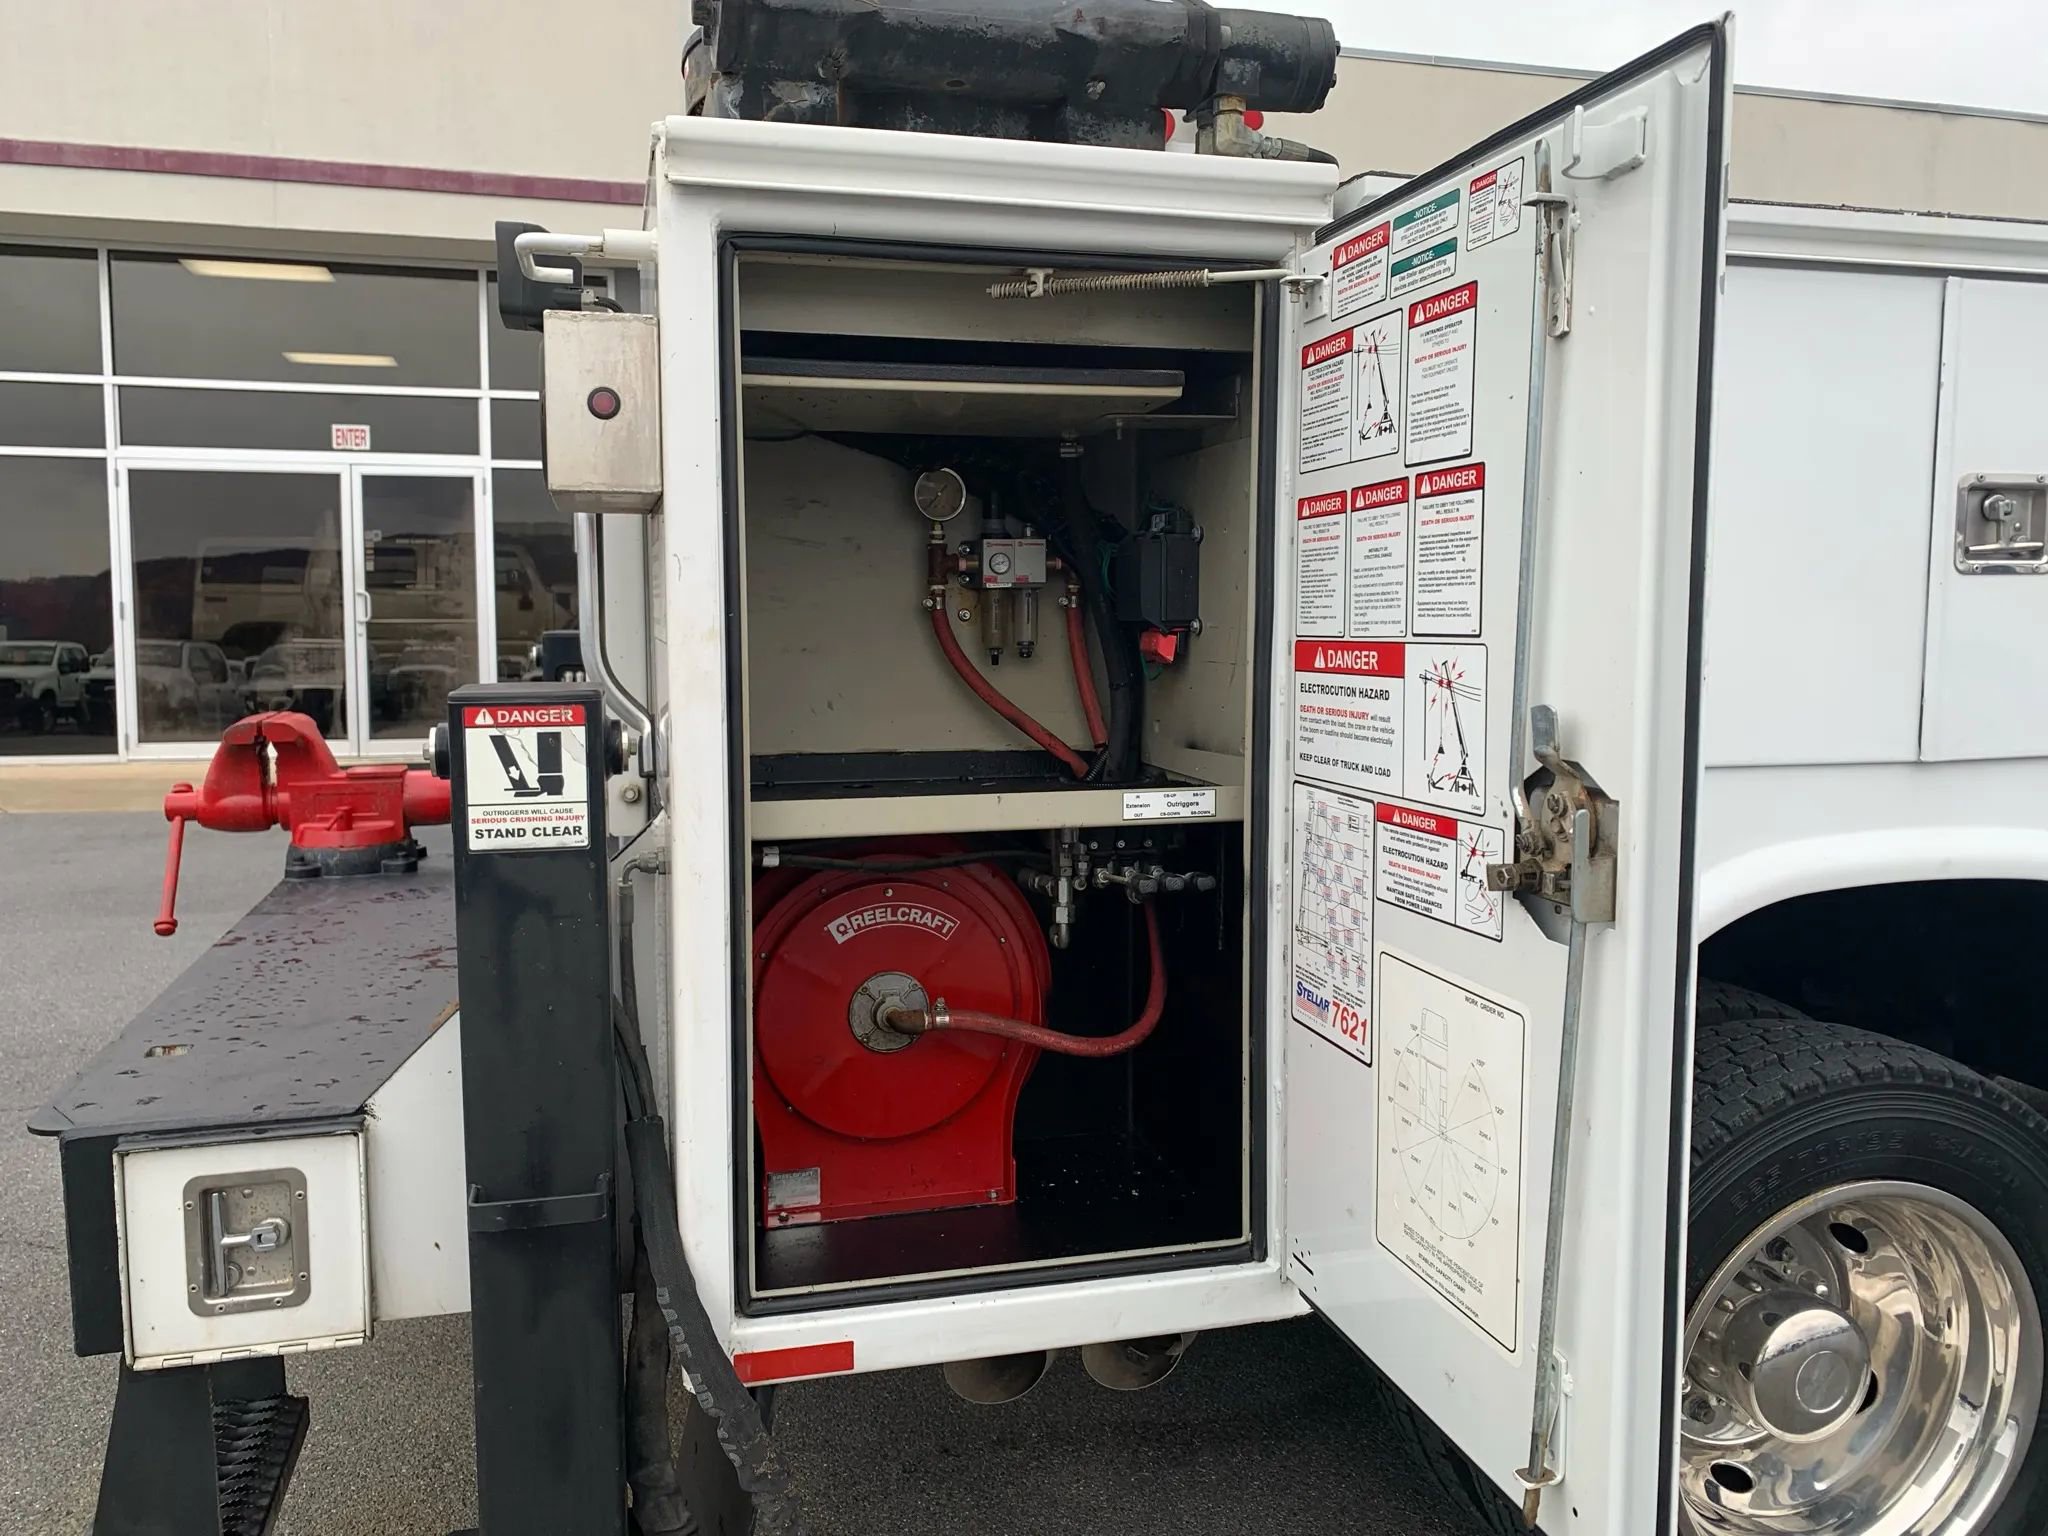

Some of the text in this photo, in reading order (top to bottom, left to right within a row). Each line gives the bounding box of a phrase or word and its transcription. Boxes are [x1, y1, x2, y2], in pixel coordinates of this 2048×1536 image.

[1477, 174, 1496, 187] DANGER
[1348, 230, 1384, 259] DANGER
[1426, 290, 1469, 318] DANGER
[1316, 337, 1346, 360] DANGER
[1415, 355, 1427, 364] DEATH
[1434, 348, 1451, 357] SERIOUS
[1452, 344, 1467, 352] INJURY
[336, 429, 367, 447] ENTER
[1433, 470, 1476, 490] DANGER
[1366, 486, 1402, 504] DANGER
[1311, 497, 1341, 514] DANGER
[1328, 650, 1378, 670] DANGER
[1300, 683, 1390, 700] ELECTROCUTION HAZARD
[497, 710, 573, 722] DANGER
[1300, 705, 1316, 714] DEATH
[1317, 706, 1324, 714] OR
[1325, 707, 1348, 718] SERIOUS
[1349, 710, 1370, 720] INJURY
[1379, 715, 1391, 723] result
[1325, 729, 1339, 737] loadline
[1340, 731, 1354, 739] should
[1370, 736, 1393, 747] electrically
[1299, 753, 1391, 777] KEEP CLEAR OF TRUCK AND LOAD
[1402, 812, 1437, 831] DANGER
[475, 826, 582, 839] STAND CLEAR
[1382, 845, 1448, 870] ELECTROCUTION HAZARD
[1408, 864, 1425, 876] SERIOUS
[1426, 870, 1441, 880] INJURY
[1386, 886, 1442, 909] MAINTAIN SAFE CLEARANCES
[1395, 896, 1432, 913] FROM POWER LINES
[851, 907, 955, 934] REELCRAFT
[1297, 981, 1330, 1012] STELLAR
[1480, 1003, 1496, 1015] ORDER
[1332, 1000, 1367, 1046] 7621
